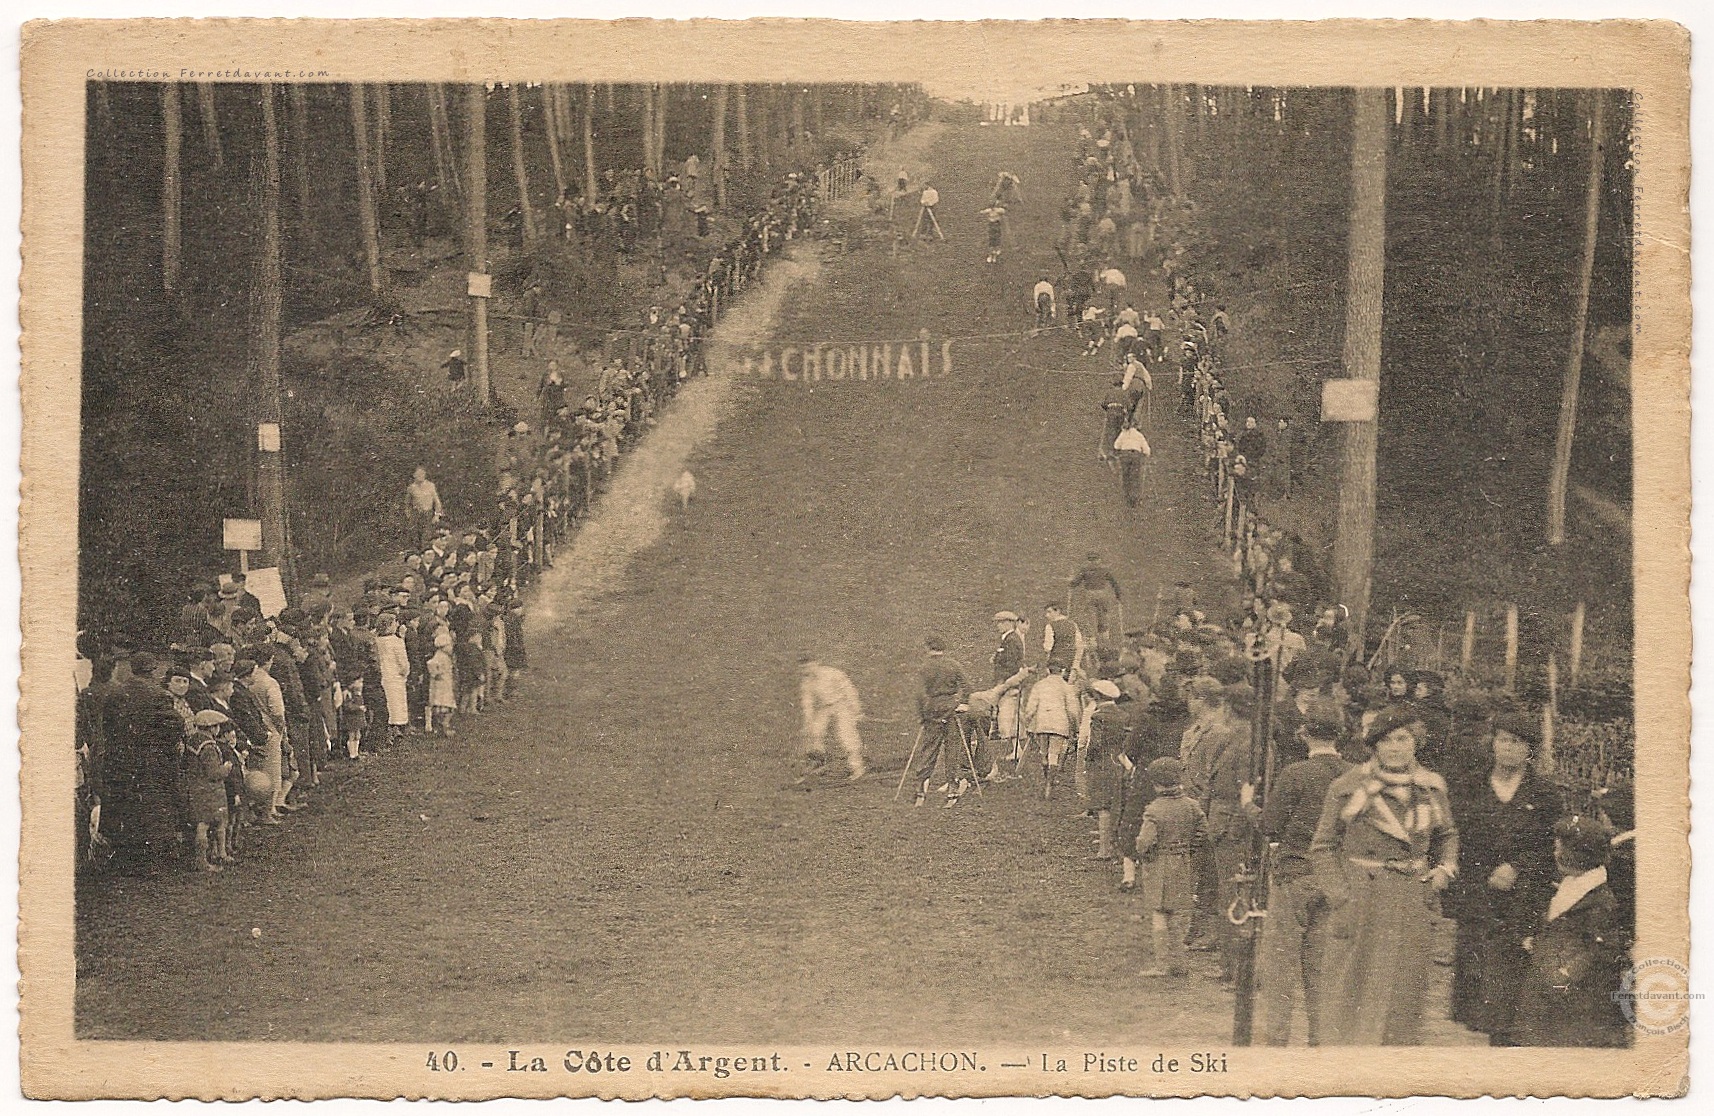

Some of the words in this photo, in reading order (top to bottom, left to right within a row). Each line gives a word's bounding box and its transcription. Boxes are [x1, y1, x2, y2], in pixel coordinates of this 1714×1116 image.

[425, 1050, 466, 1072] 40.
[506, 1050, 548, 1073] La
[563, 1050, 631, 1073] Côte
[646, 1050, 788, 1079] d'Argent.
[826, 1051, 987, 1072] ARCACHON.
[1042, 1053, 1068, 1073] La
[1083, 1052, 1139, 1073] Piste
[1151, 1053, 1181, 1073] de
[1190, 1052, 1229, 1073] Ski
